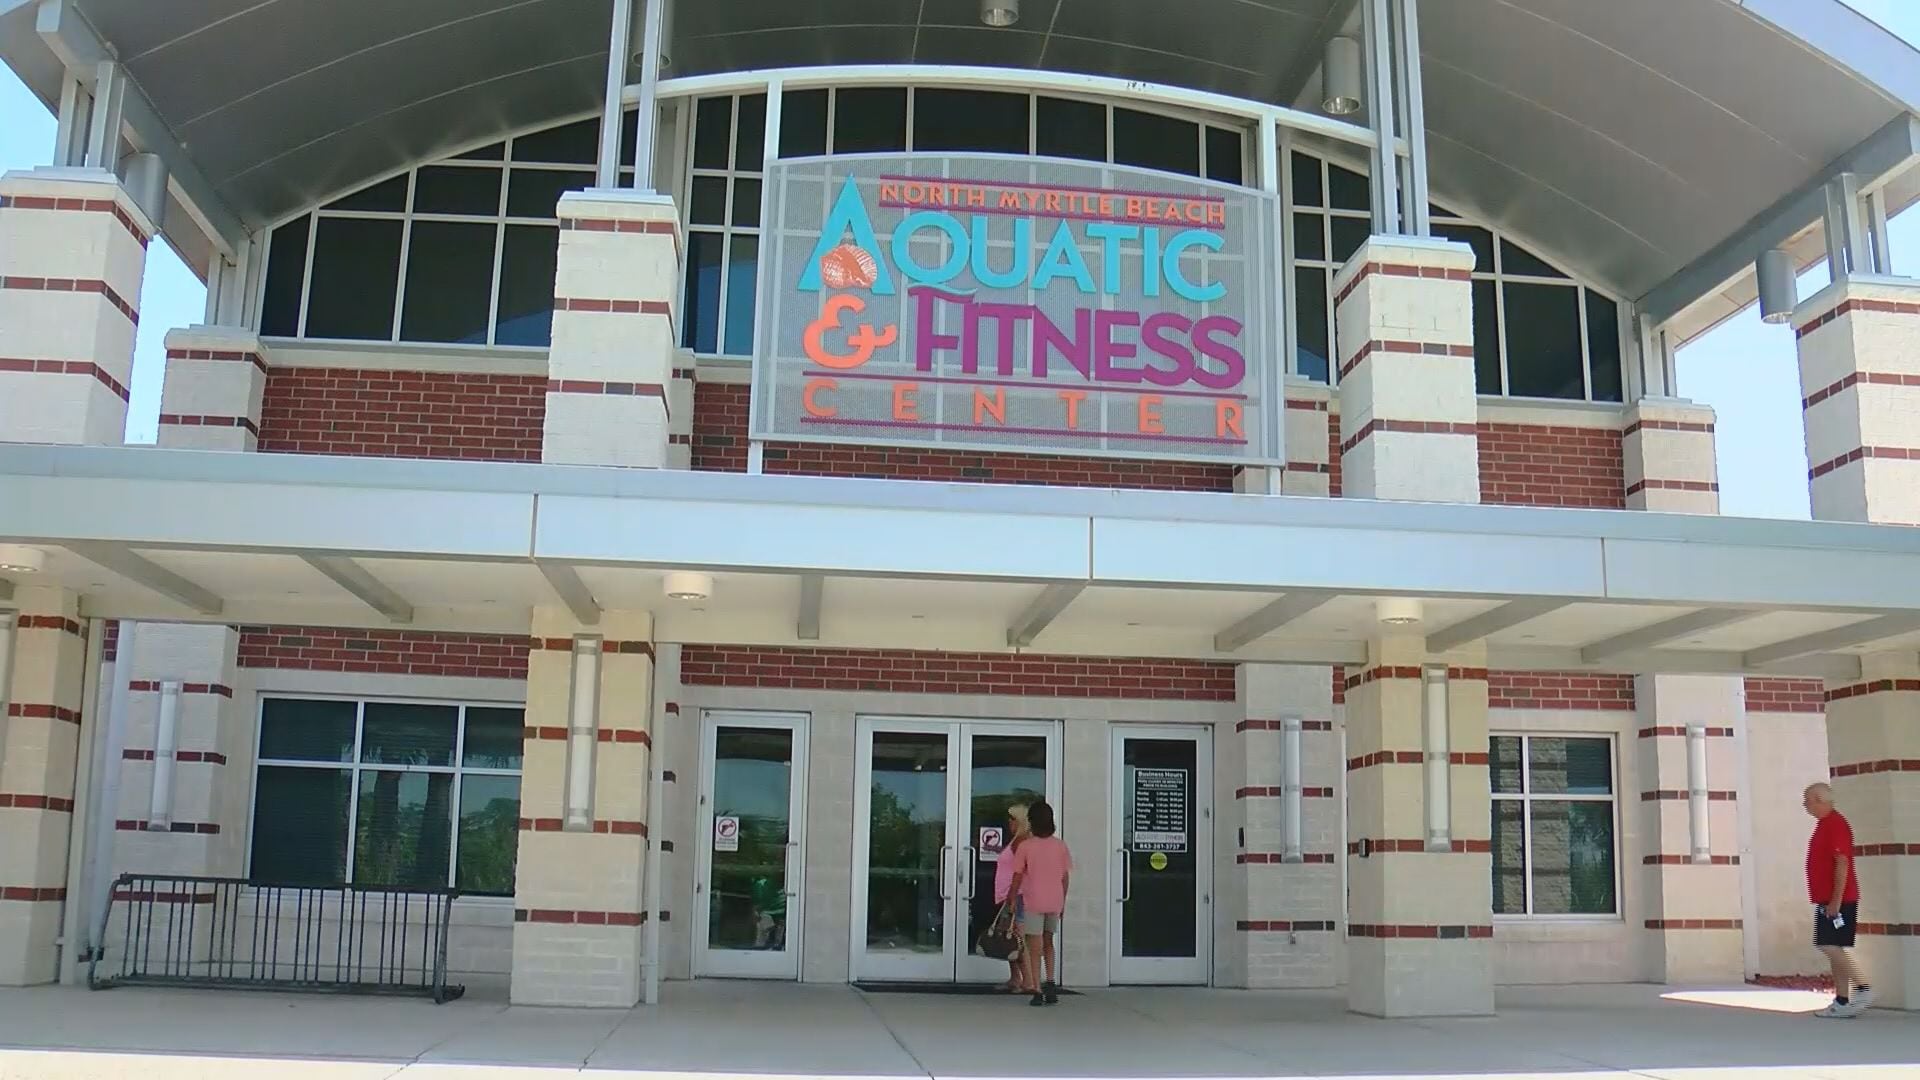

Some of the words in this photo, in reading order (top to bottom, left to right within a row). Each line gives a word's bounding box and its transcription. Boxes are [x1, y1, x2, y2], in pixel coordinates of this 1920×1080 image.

[797, 172, 1228, 302] AQUATIC
[880, 182, 985, 208] NORTH
[998, 190, 1112, 217] MYRTLE
[1126, 197, 1226, 225] BEACH
[803, 294, 897, 369] &
[907, 286, 1247, 389] FITNESS
[802, 378, 1246, 438] CENTER
